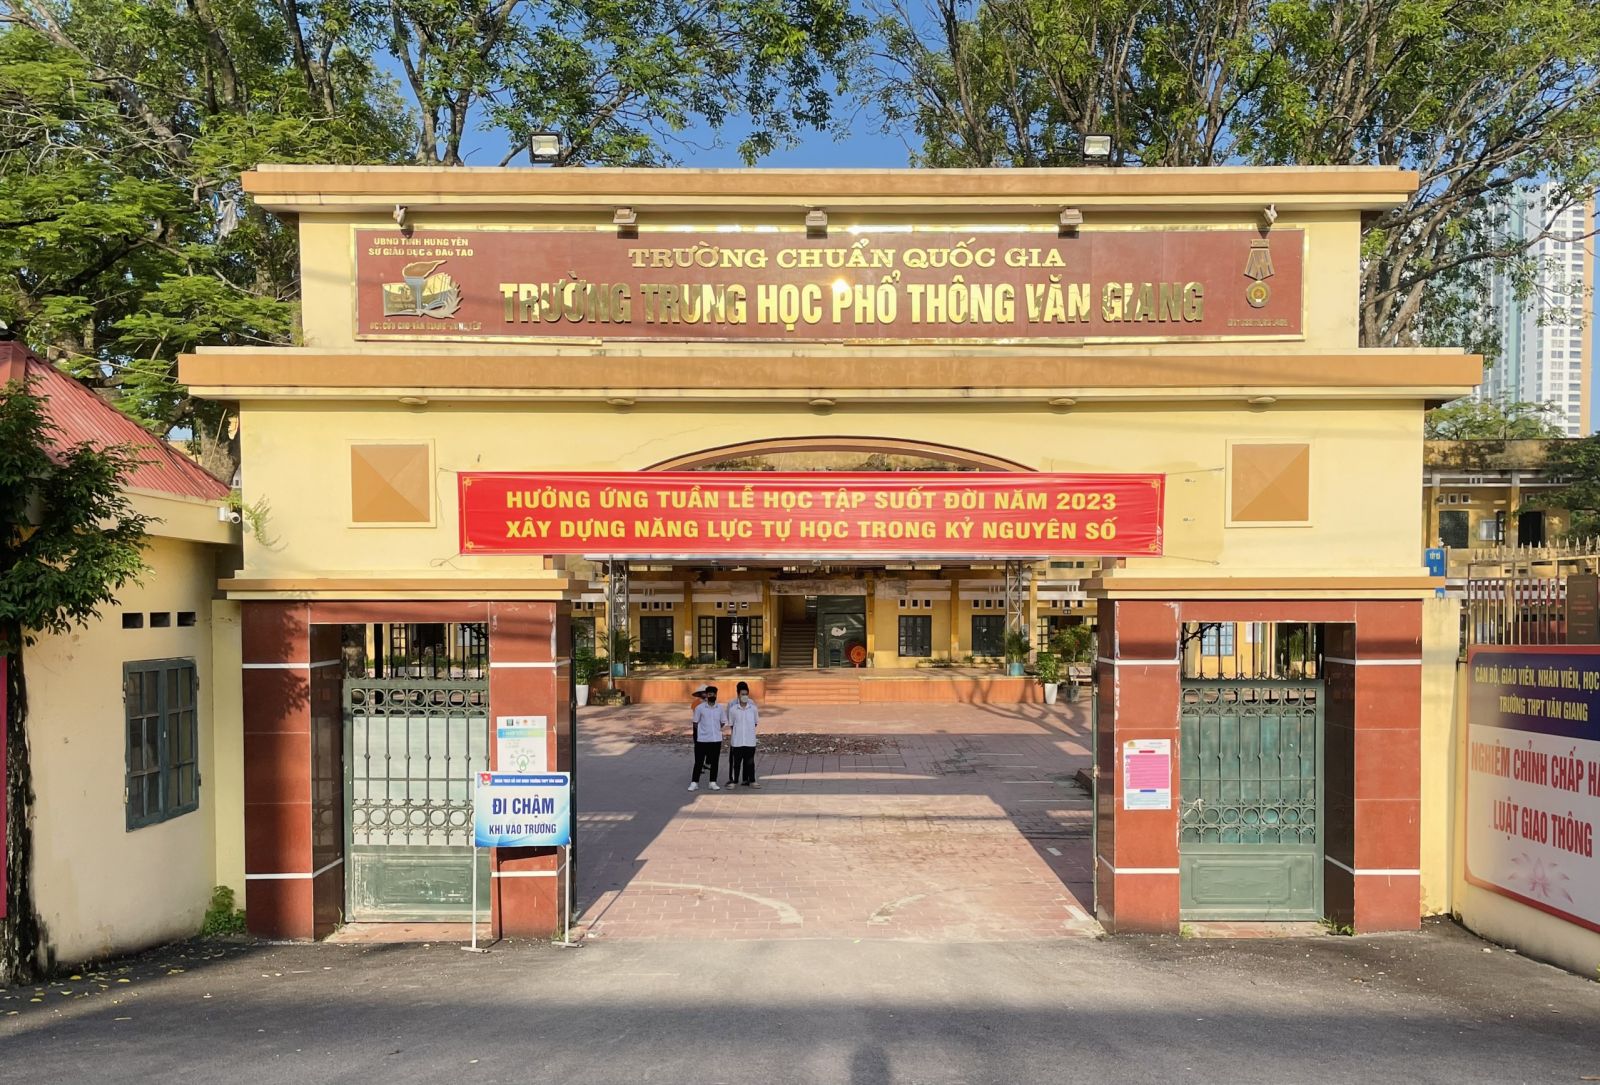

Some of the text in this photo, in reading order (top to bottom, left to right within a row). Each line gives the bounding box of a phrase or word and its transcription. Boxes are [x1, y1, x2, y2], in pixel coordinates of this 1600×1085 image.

[450, 236, 469, 247] YÊN
[628, 237, 1066, 269] TRƯỜNG CHUẨN QUỐC GIA
[499, 269, 1205, 331] TRƯỜNG TRUNG HỌC PHỔ THÔNG VĂN GIANG
[506, 483, 1117, 512] HƯỞNG ỨNG TUẦN LỄ HỌC TẬP SUỐT ĐỜI NĂM 2023
[505, 516, 1118, 542] XÂY DỰNG NĂNG LỰC TỰ HỌC TRONG KỶ NGUYÊN SỐ
[1474, 663, 1488, 683] CÁN
[1501, 664, 1517, 685] GIÁO
[1537, 666, 1559, 688] NHÂN
[1560, 666, 1581, 691] VIÊN,
[1582, 670, 1600, 694] HỌC
[1499, 693, 1589, 722] TRƯỜNG THPT VĂN GIANG
[1471, 738, 1511, 778] NGHIÊM
[1513, 739, 1548, 787] CHỈNH
[1551, 745, 1585, 793] CHẤP
[492, 794, 554, 818] ĐI CHẬM
[488, 824, 503, 835] KHI
[1493, 795, 1593, 858] LUẬT GIAO THÔNG
